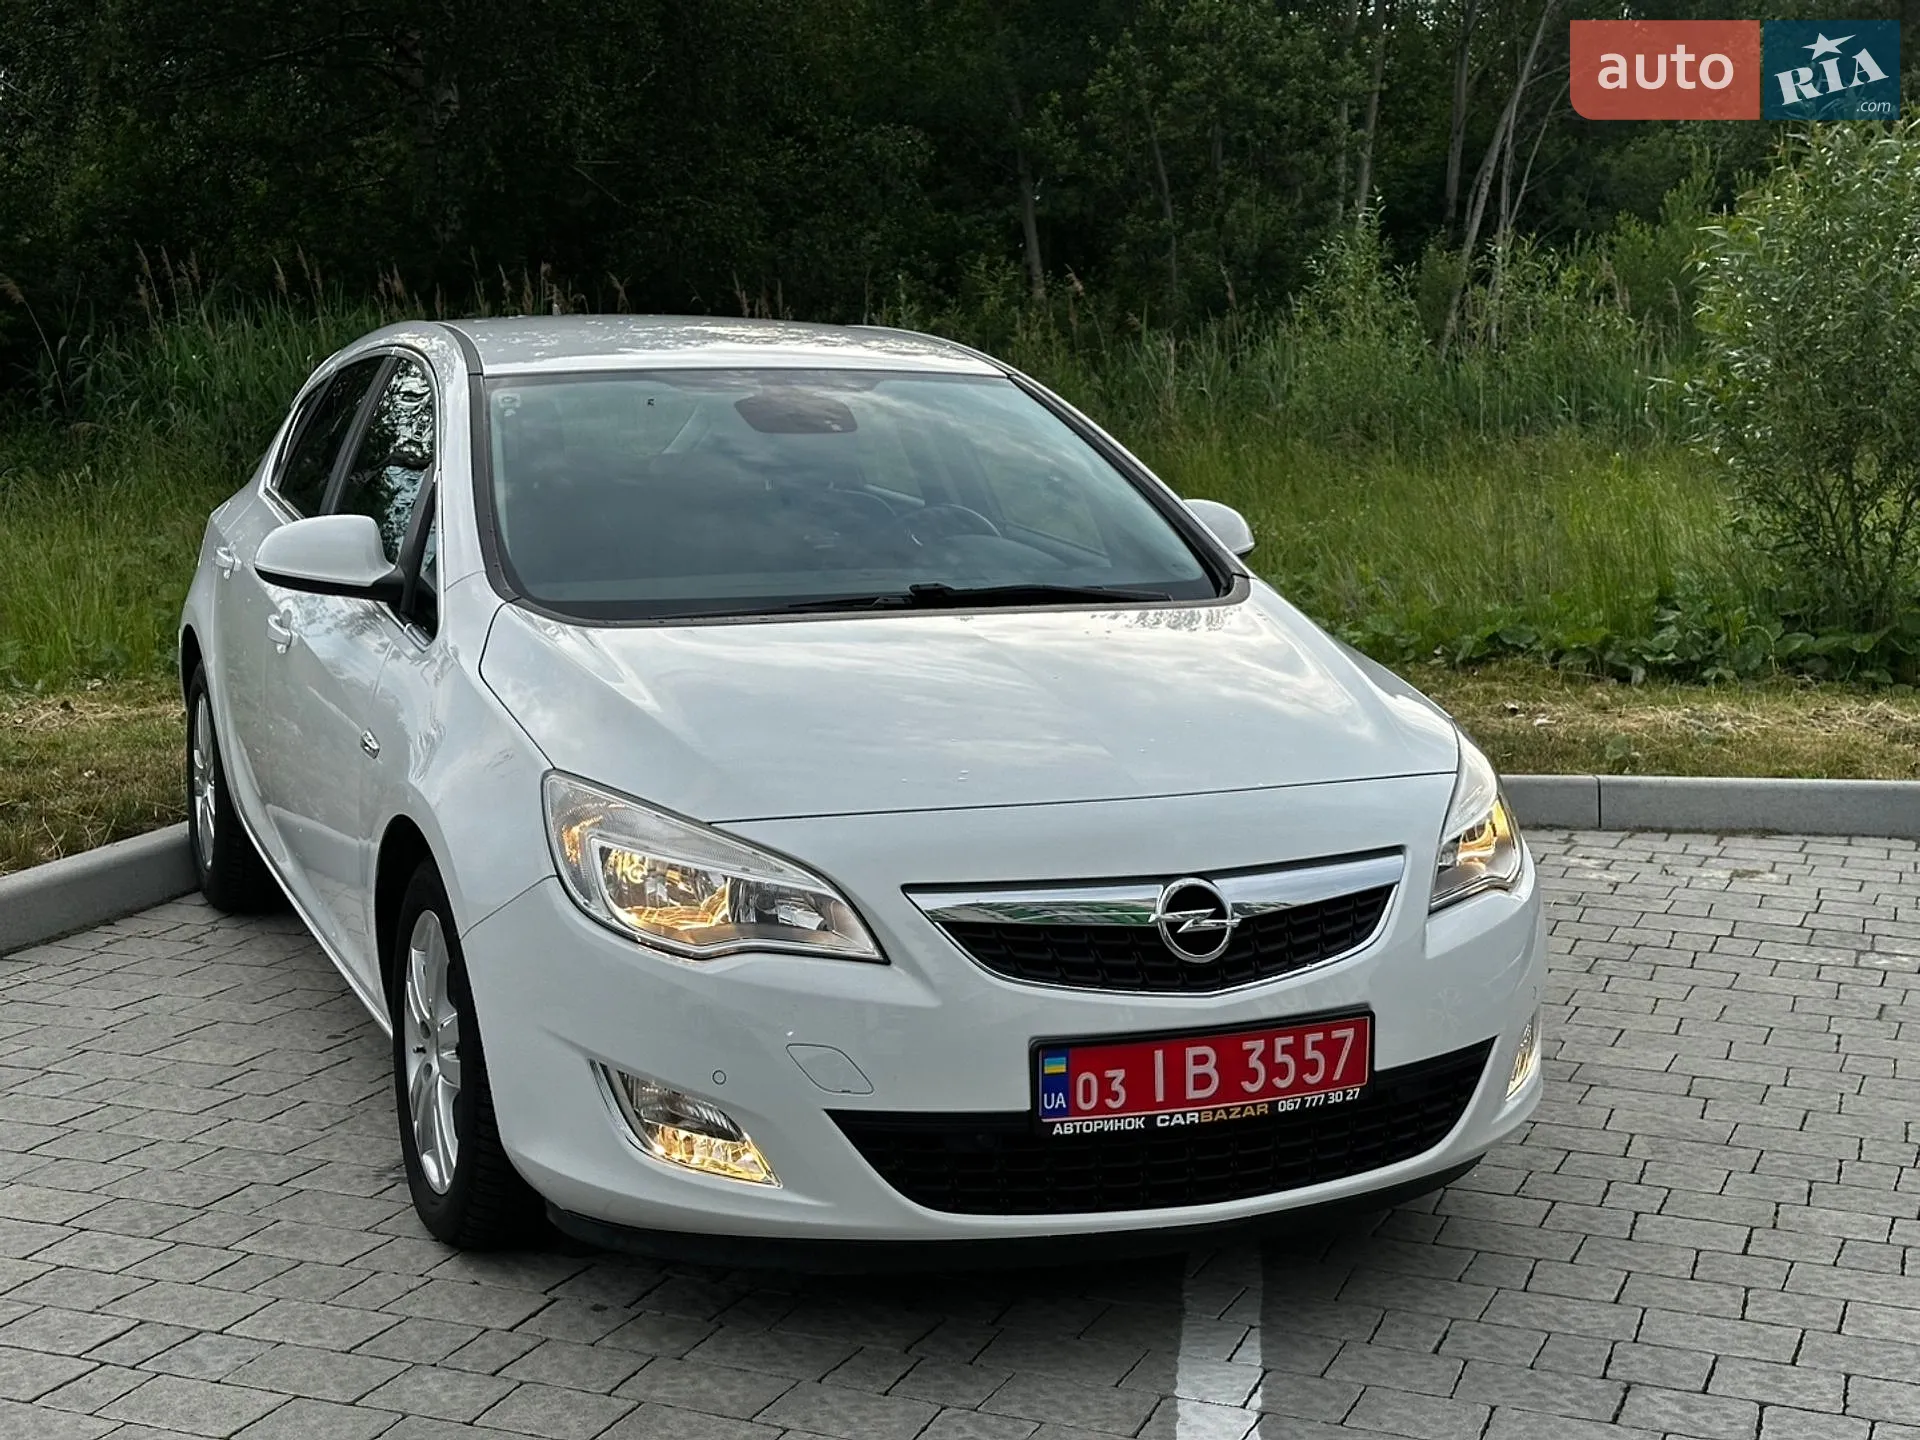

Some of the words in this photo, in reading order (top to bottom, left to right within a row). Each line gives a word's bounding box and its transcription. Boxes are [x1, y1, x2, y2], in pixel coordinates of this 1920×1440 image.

[1076, 1069, 1126, 1110] 03
[1154, 1046, 1219, 1102] IB
[1241, 1028, 1354, 1092] 3557
[1043, 1093, 1066, 1110] UA
[1053, 1117, 1145, 1135] АВТОРИНОК
[1156, 1104, 1269, 1127] CARBAZAR
[1278, 1100, 1302, 1112] 067
[1305, 1094, 1325, 1108] 777
[1327, 1092, 1343, 1104] 30
[1345, 1088, 1360, 1101] 27
